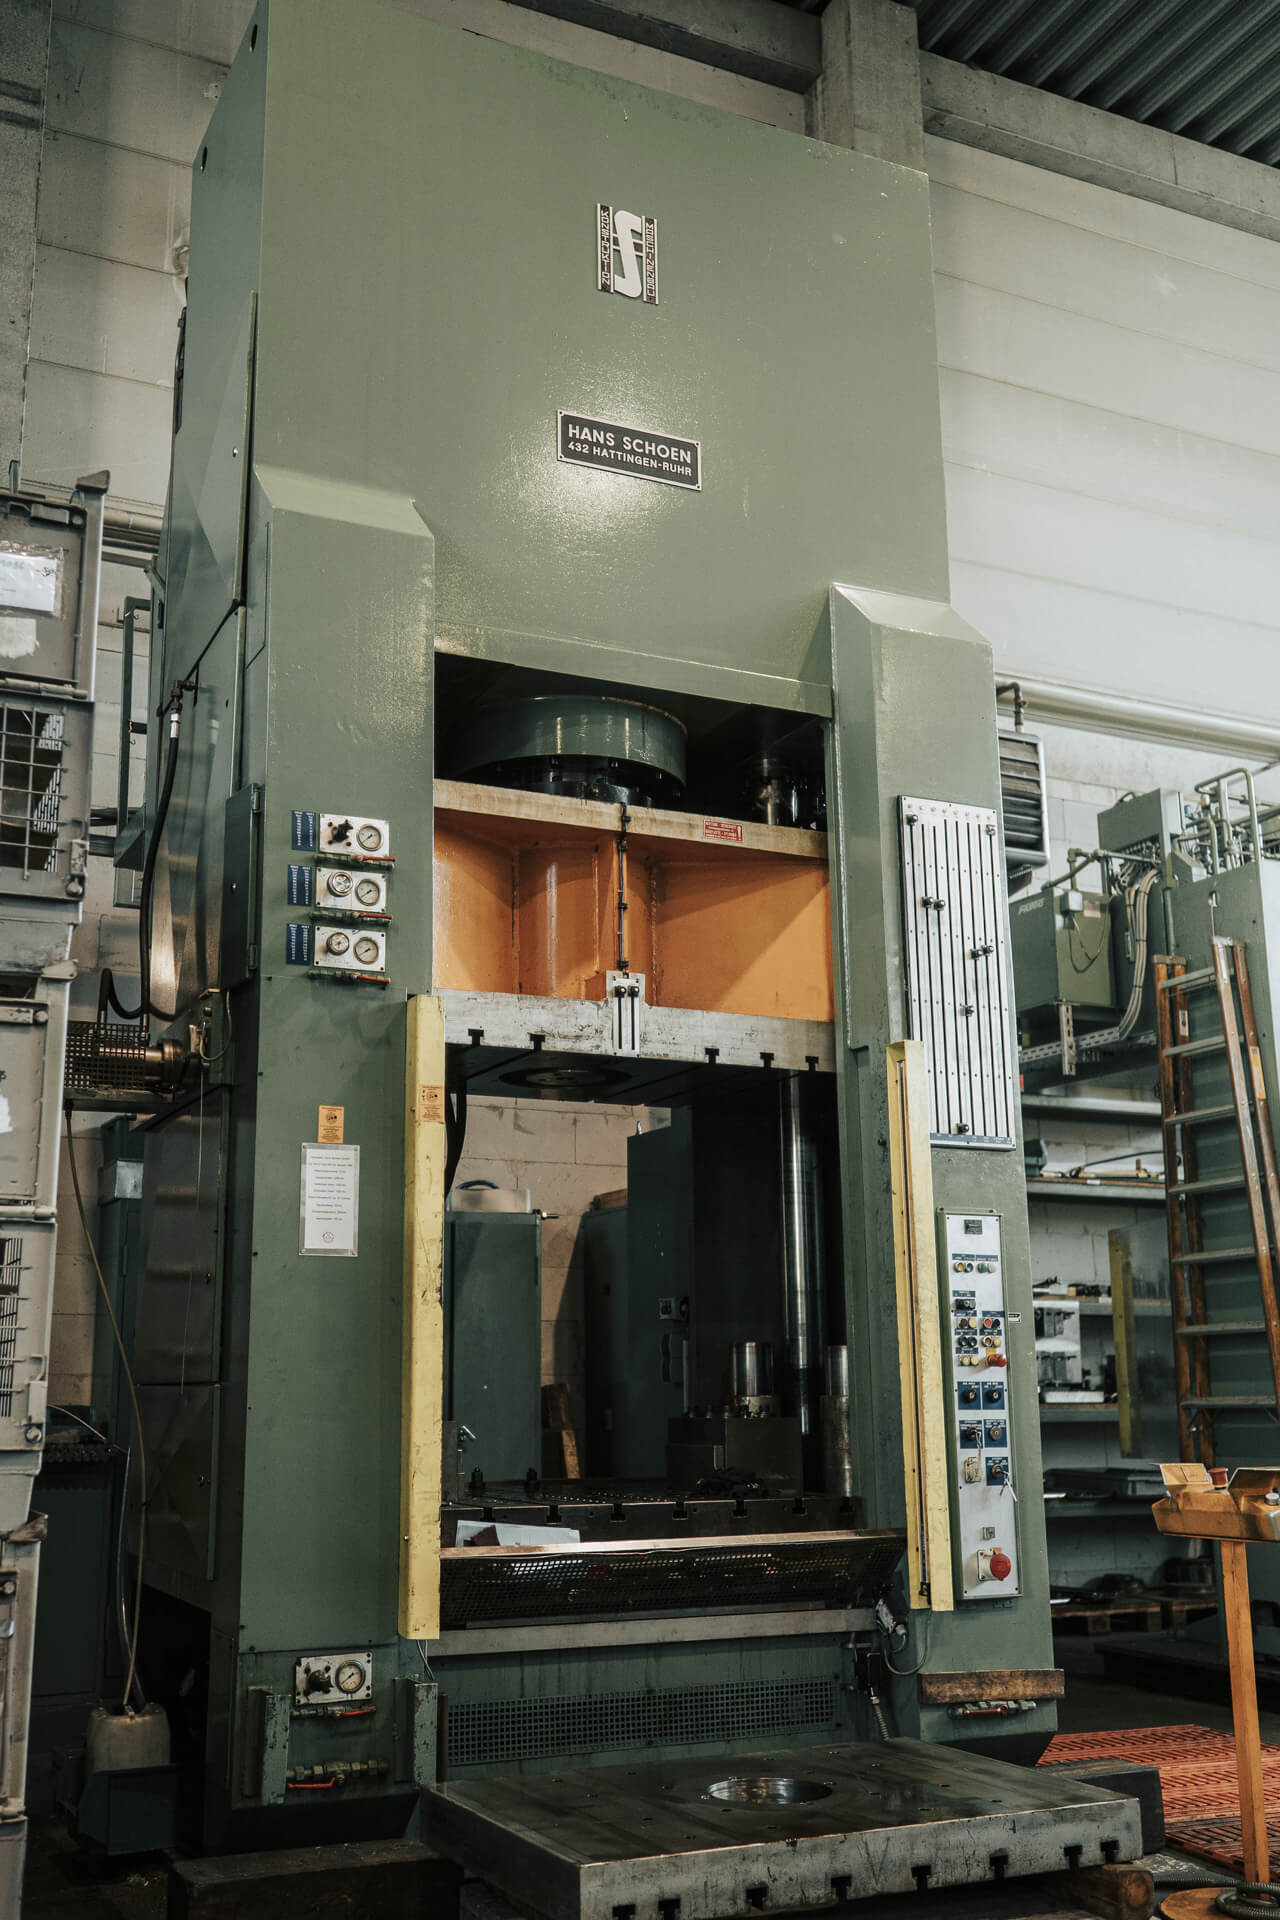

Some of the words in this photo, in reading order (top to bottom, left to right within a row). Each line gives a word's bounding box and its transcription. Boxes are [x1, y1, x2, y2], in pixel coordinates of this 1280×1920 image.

[600, 209, 610, 285] KONSTRUKTION
[646, 222, 655, 297] MASCHINENBAU
[568, 424, 615, 446] HANS
[623, 436, 692, 464] SCHOEN
[568, 441, 589, 453] 432
[593, 446, 692, 477] HATTINGEN-RUHR
